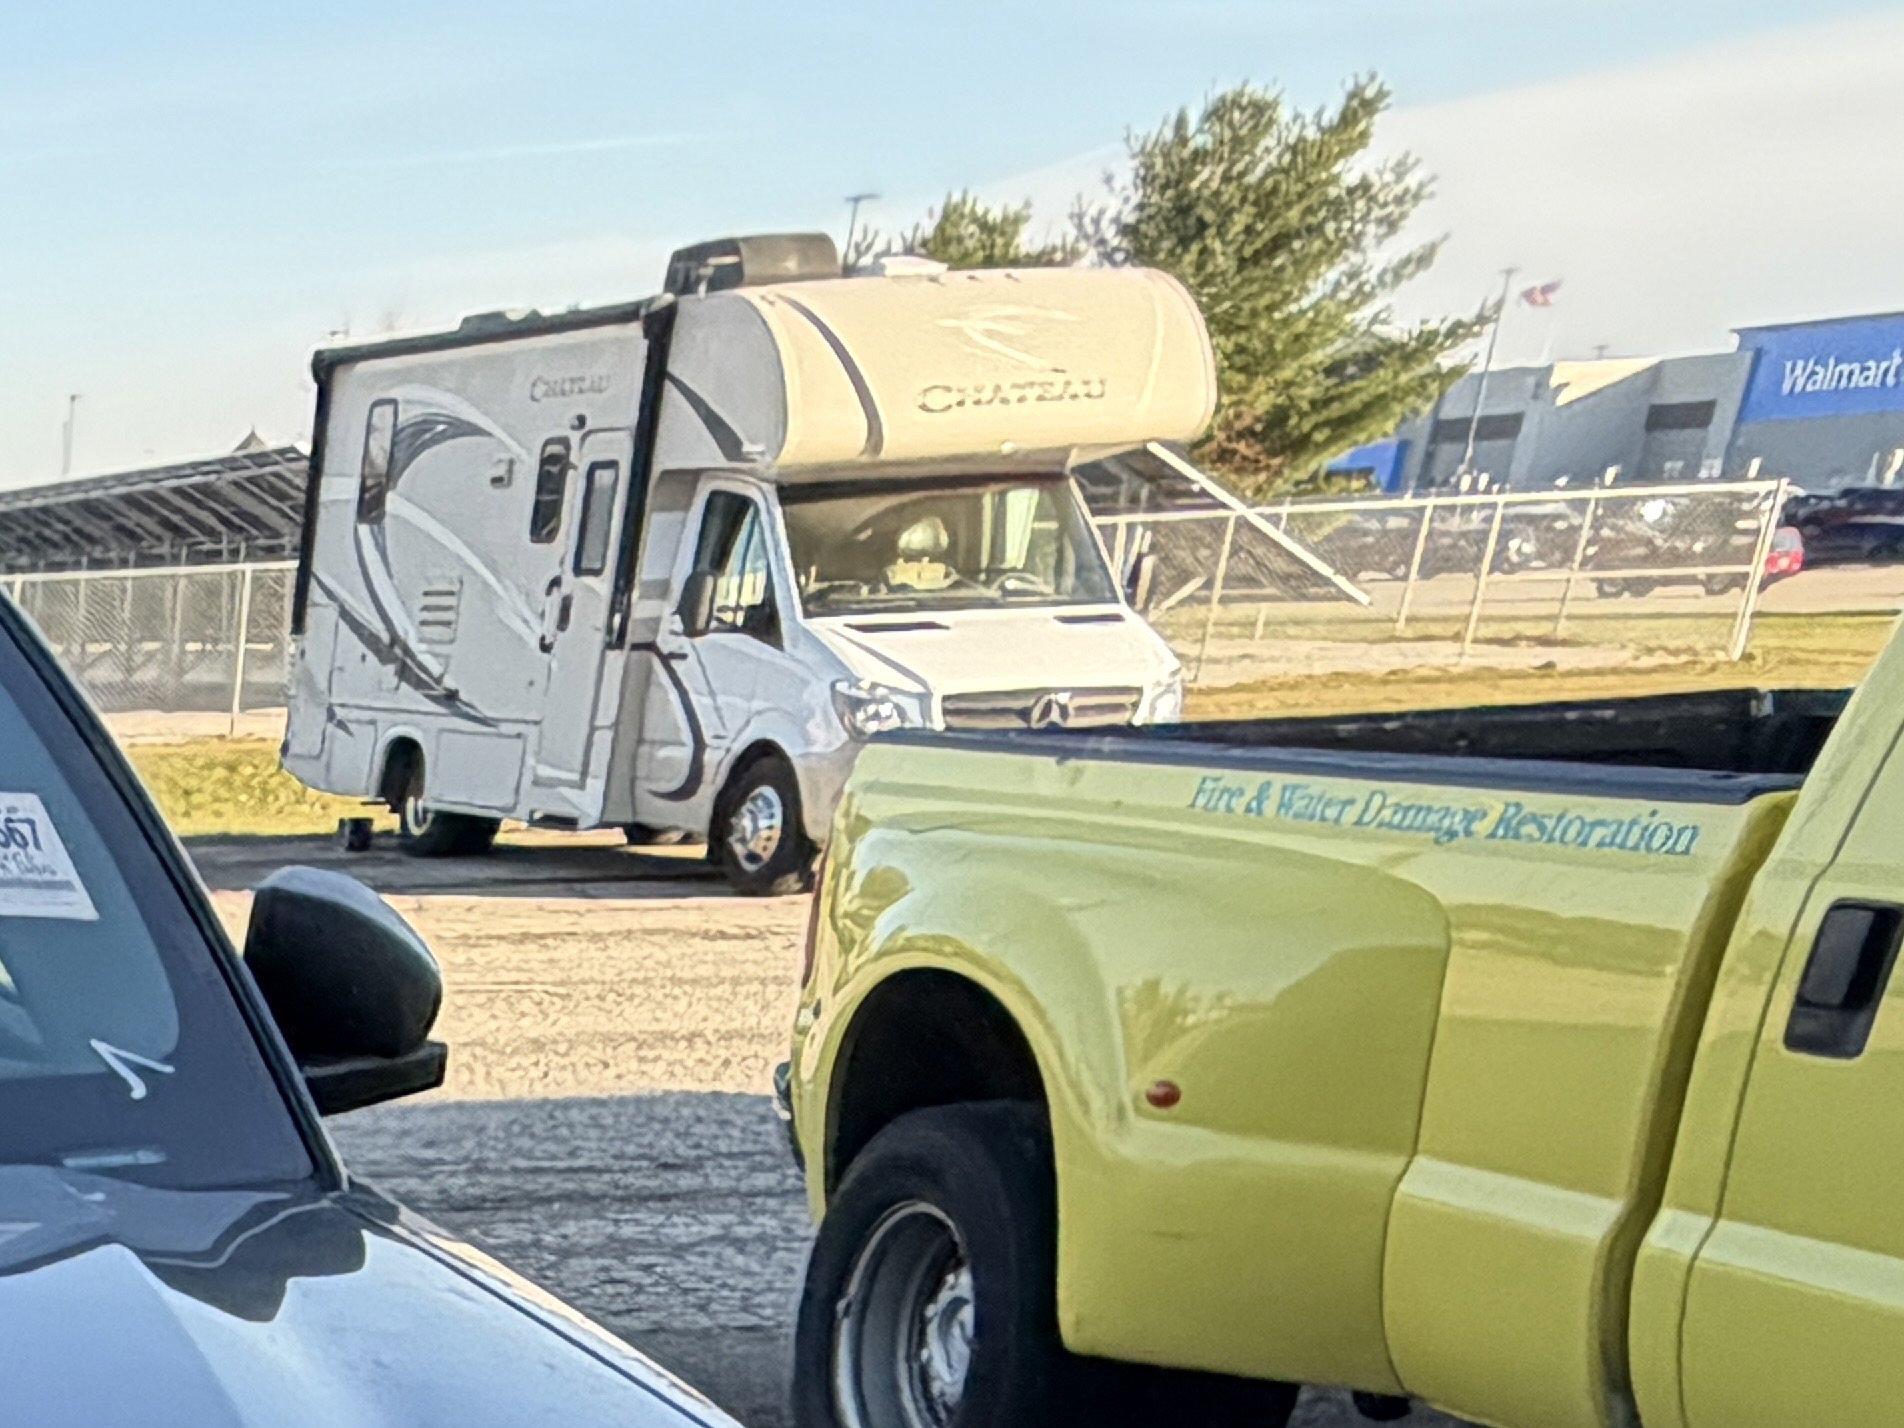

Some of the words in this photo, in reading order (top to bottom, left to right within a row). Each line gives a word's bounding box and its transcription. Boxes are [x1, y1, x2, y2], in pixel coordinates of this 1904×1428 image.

[917, 378, 1106, 413] CHATEAU
[1782, 348, 1903, 396] Walmart
[1191, 776, 1245, 815] Fire
[1246, 780, 1273, 817] &
[1275, 782, 1359, 825] Water
[1353, 789, 1489, 844] Damage
[1485, 801, 1701, 856] Restoration
